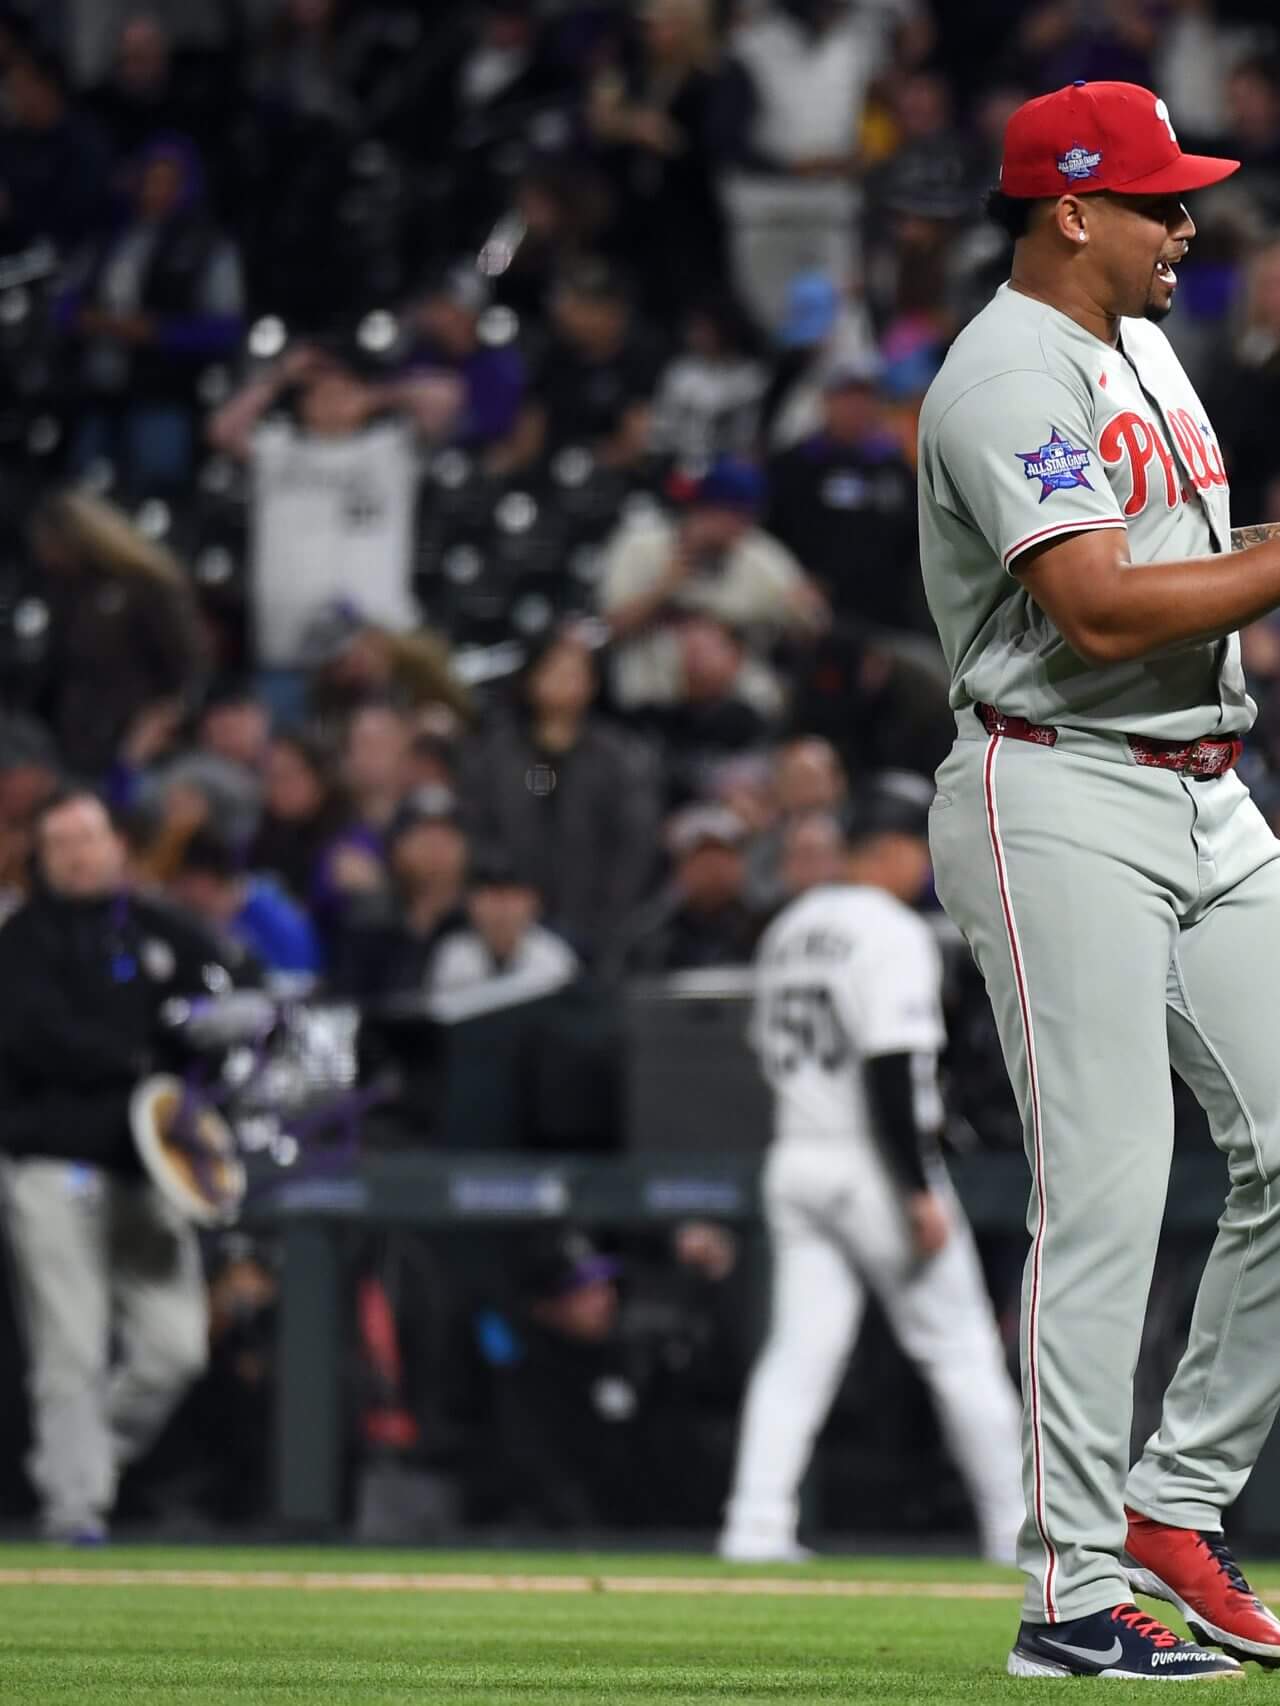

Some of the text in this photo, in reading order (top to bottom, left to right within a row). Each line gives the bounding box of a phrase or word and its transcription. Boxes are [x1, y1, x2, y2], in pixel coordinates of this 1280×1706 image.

[1027, 462, 1045, 477] ALL
[1044, 457, 1067, 472] STAR
[1066, 453, 1089, 466] GAME
